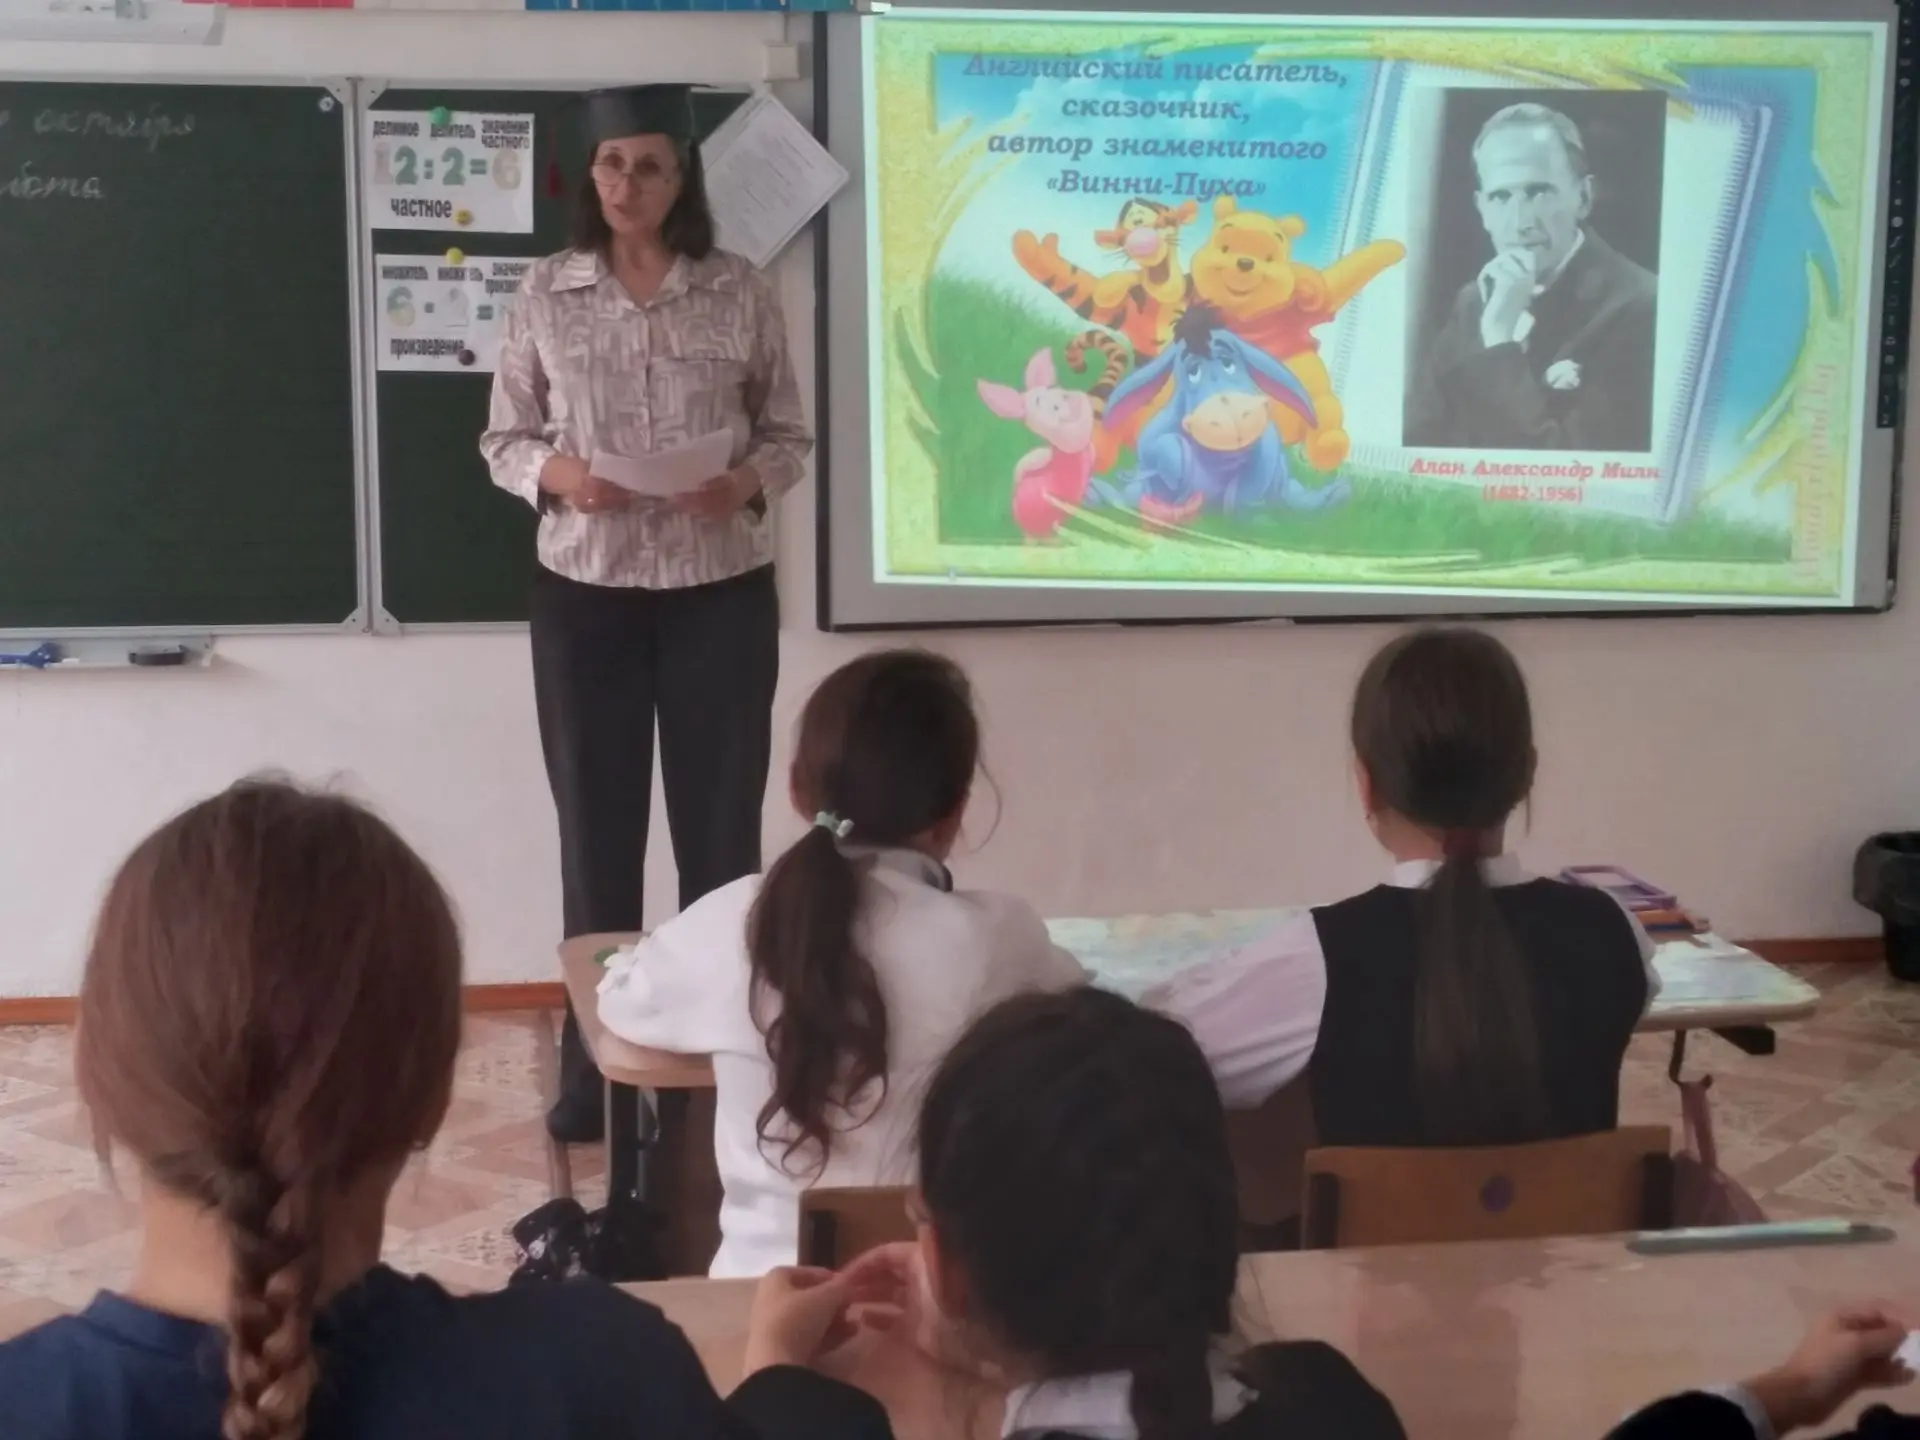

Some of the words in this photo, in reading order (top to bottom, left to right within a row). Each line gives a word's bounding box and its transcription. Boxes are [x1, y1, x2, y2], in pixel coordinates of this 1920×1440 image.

[963, 51, 1164, 80] Английский
[1173, 64, 1348, 88] писатель,
[1061, 97, 1250, 122] сказочник,
[987, 132, 1093, 161] автор
[1103, 139, 1328, 160] знаменитого
[1046, 169, 1266, 202] «Винни-Пуха»
[391, 198, 453, 218] частное
[1408, 457, 1465, 476] Алан
[1473, 459, 1595, 481] Александр
[1601, 461, 1660, 479] Милн
